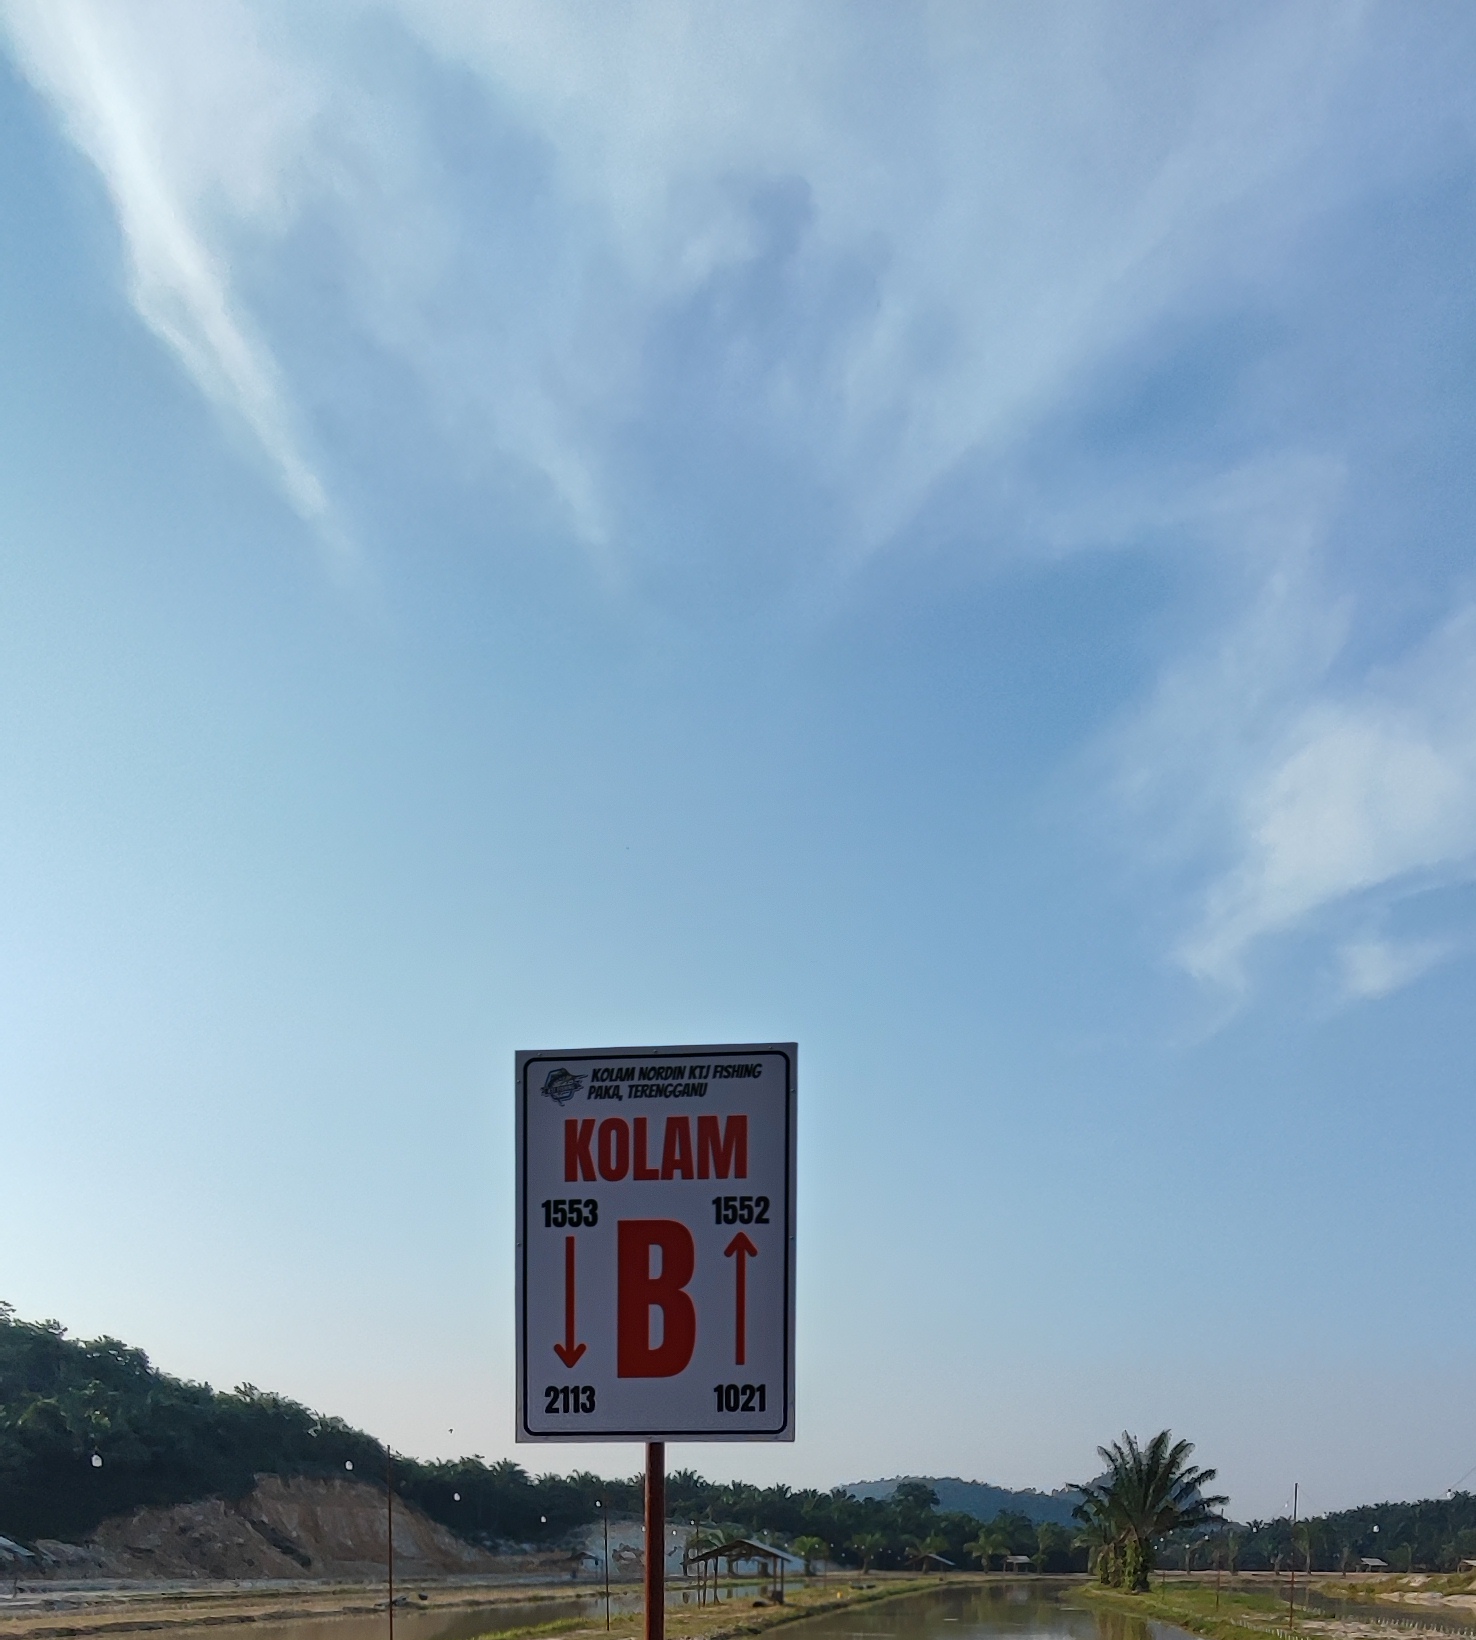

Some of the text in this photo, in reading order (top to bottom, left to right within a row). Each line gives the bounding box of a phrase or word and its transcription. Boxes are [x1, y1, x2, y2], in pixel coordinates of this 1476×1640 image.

[591, 1063, 762, 1082] KOLAM NORDIN KTJ FISHING
[587, 1085, 623, 1101] PAKA,
[627, 1083, 708, 1099] TERENGGANU
[564, 1115, 748, 1182] KOLAM
[541, 1199, 598, 1228] 1553
[712, 1196, 770, 1225] 1552
[617, 1219, 696, 1378] B
[544, 1386, 595, 1413] 2113
[714, 1384, 766, 1412] 1021
